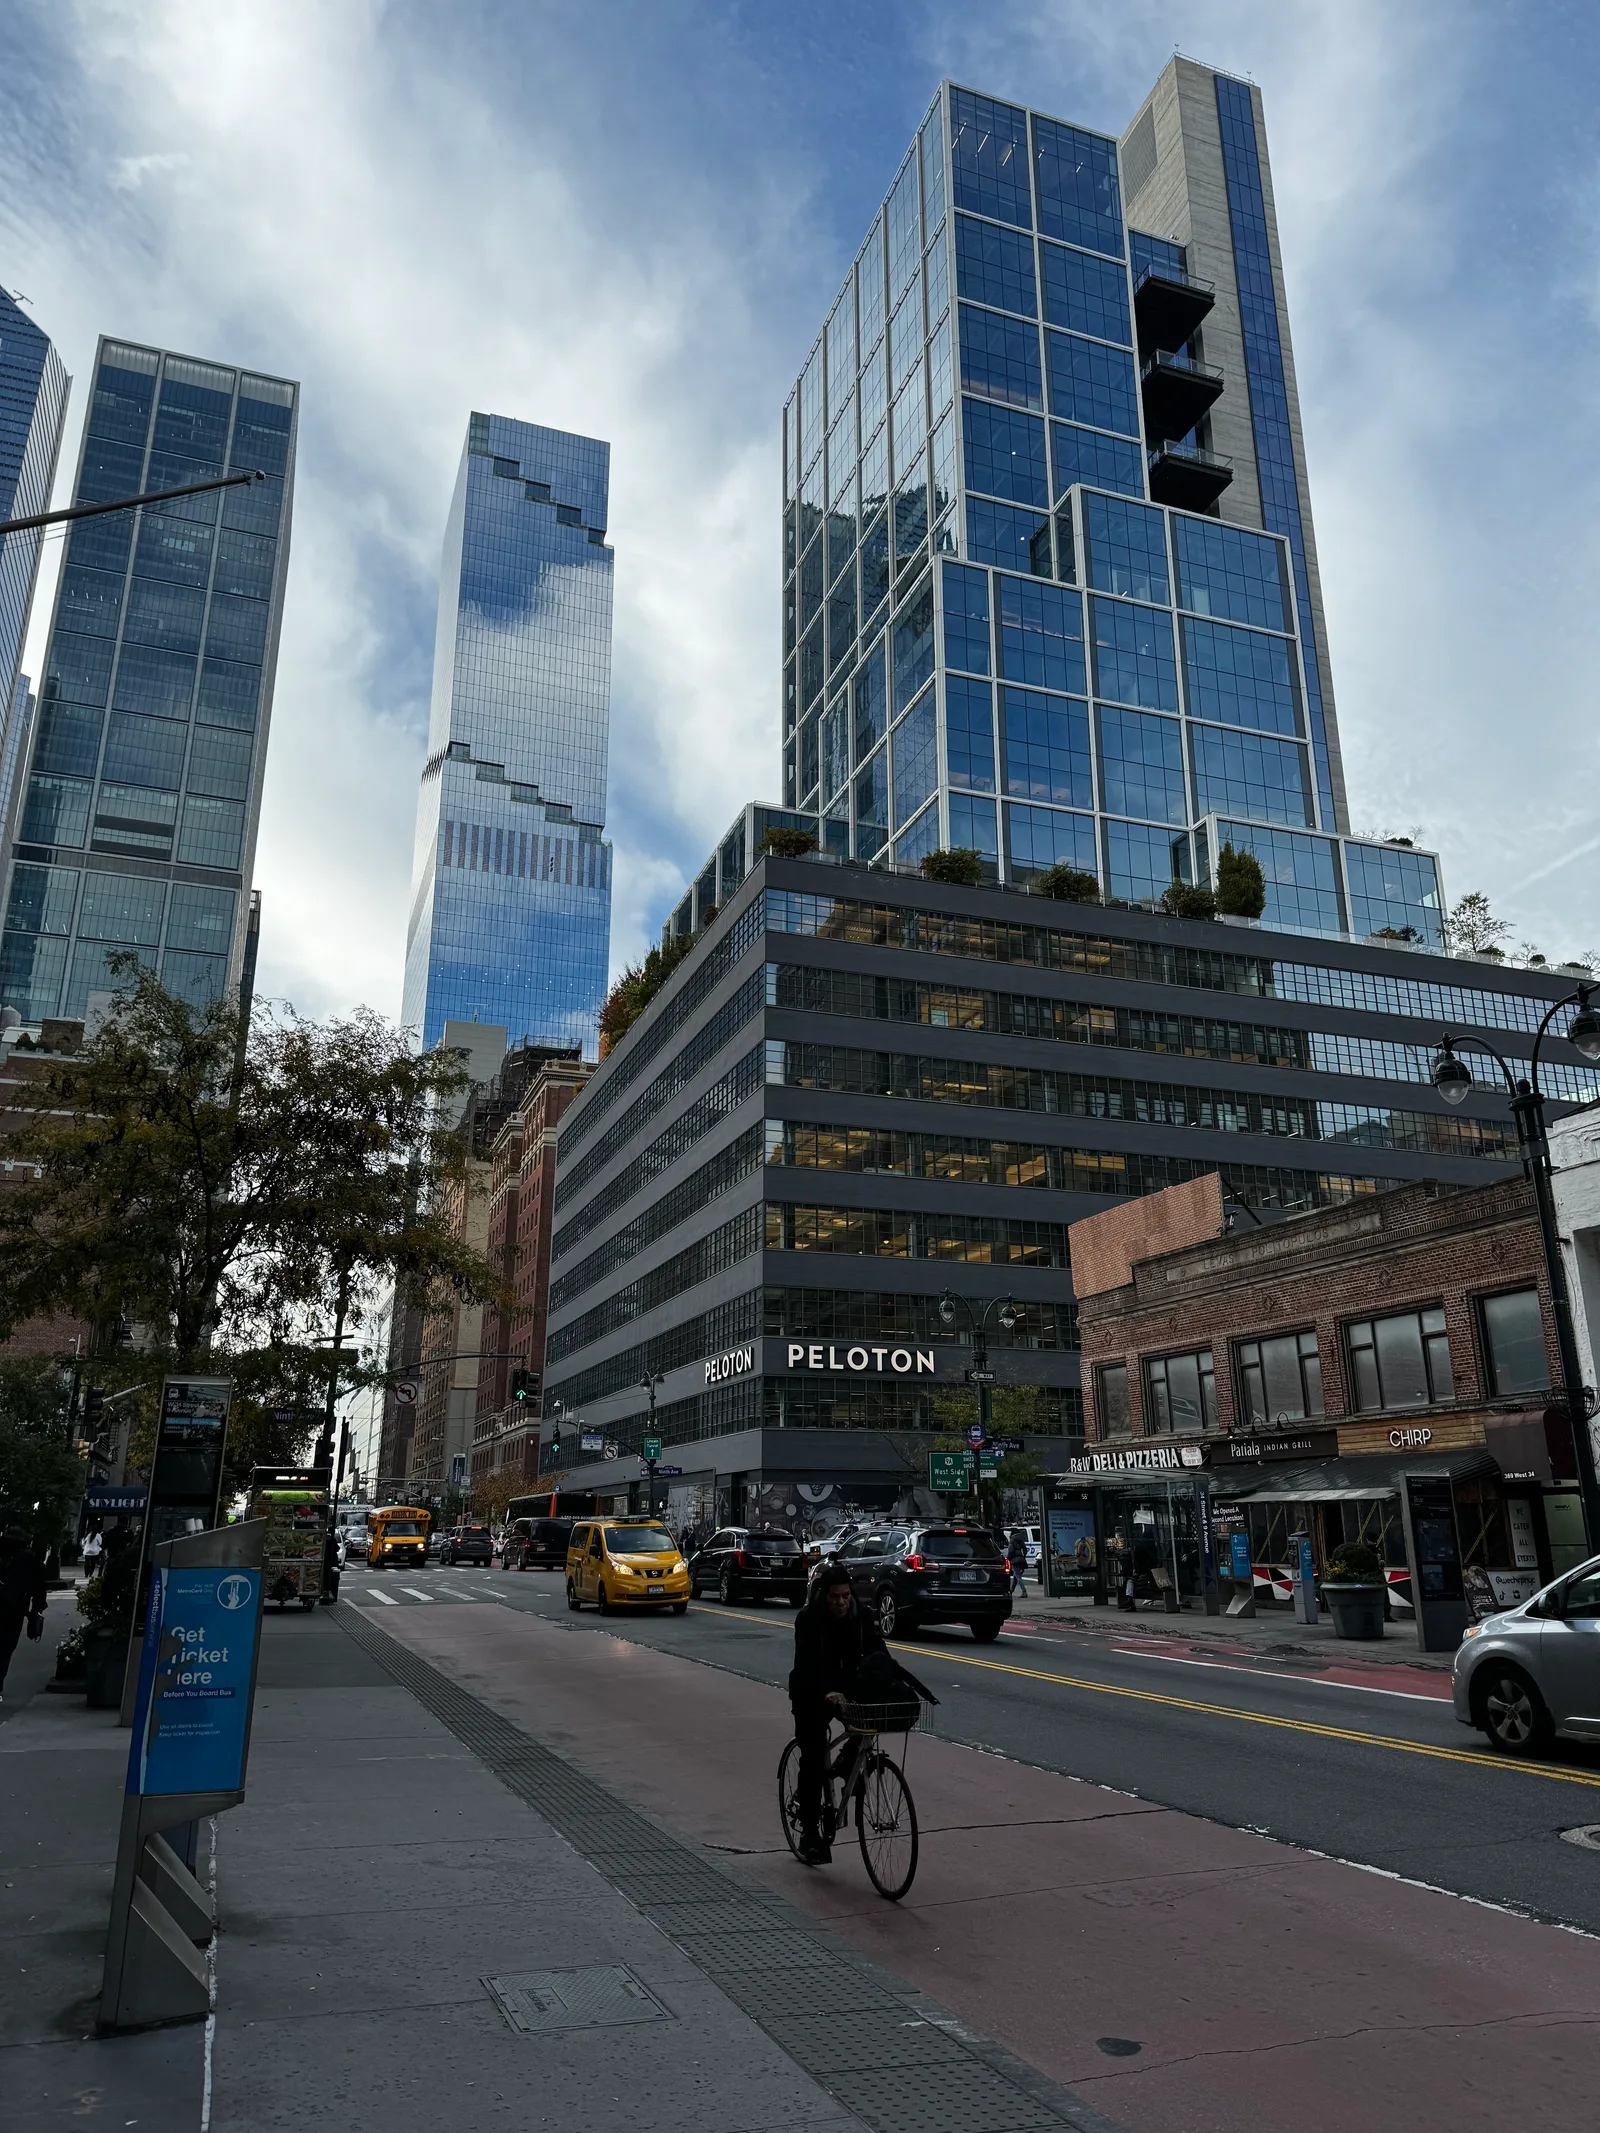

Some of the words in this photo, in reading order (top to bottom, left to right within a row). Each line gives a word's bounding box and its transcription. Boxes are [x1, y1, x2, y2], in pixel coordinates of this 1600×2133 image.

[705, 1346, 753, 1383] PELOTON
[788, 1344, 935, 1373] PELOTON
[1390, 1428, 1431, 1447] CHIRP
[1231, 1441, 1260, 1457] Patiala
[1264, 1443, 1289, 1451] INDIAN
[1291, 1440, 1312, 1449] GRILL
[1070, 1455, 1091, 1472] R&W
[1093, 1451, 1118, 1471] DELI
[1126, 1447, 1180, 1469] PIZZERIA
[936, 1479, 951, 1487] Hwy
[89, 1497, 147, 1508] SKYLIGHT
[1517, 1554, 1536, 1562] EVENTS
[1495, 1576, 1536, 1585] @wechirpnyc
[171, 1626, 206, 1643] Get
